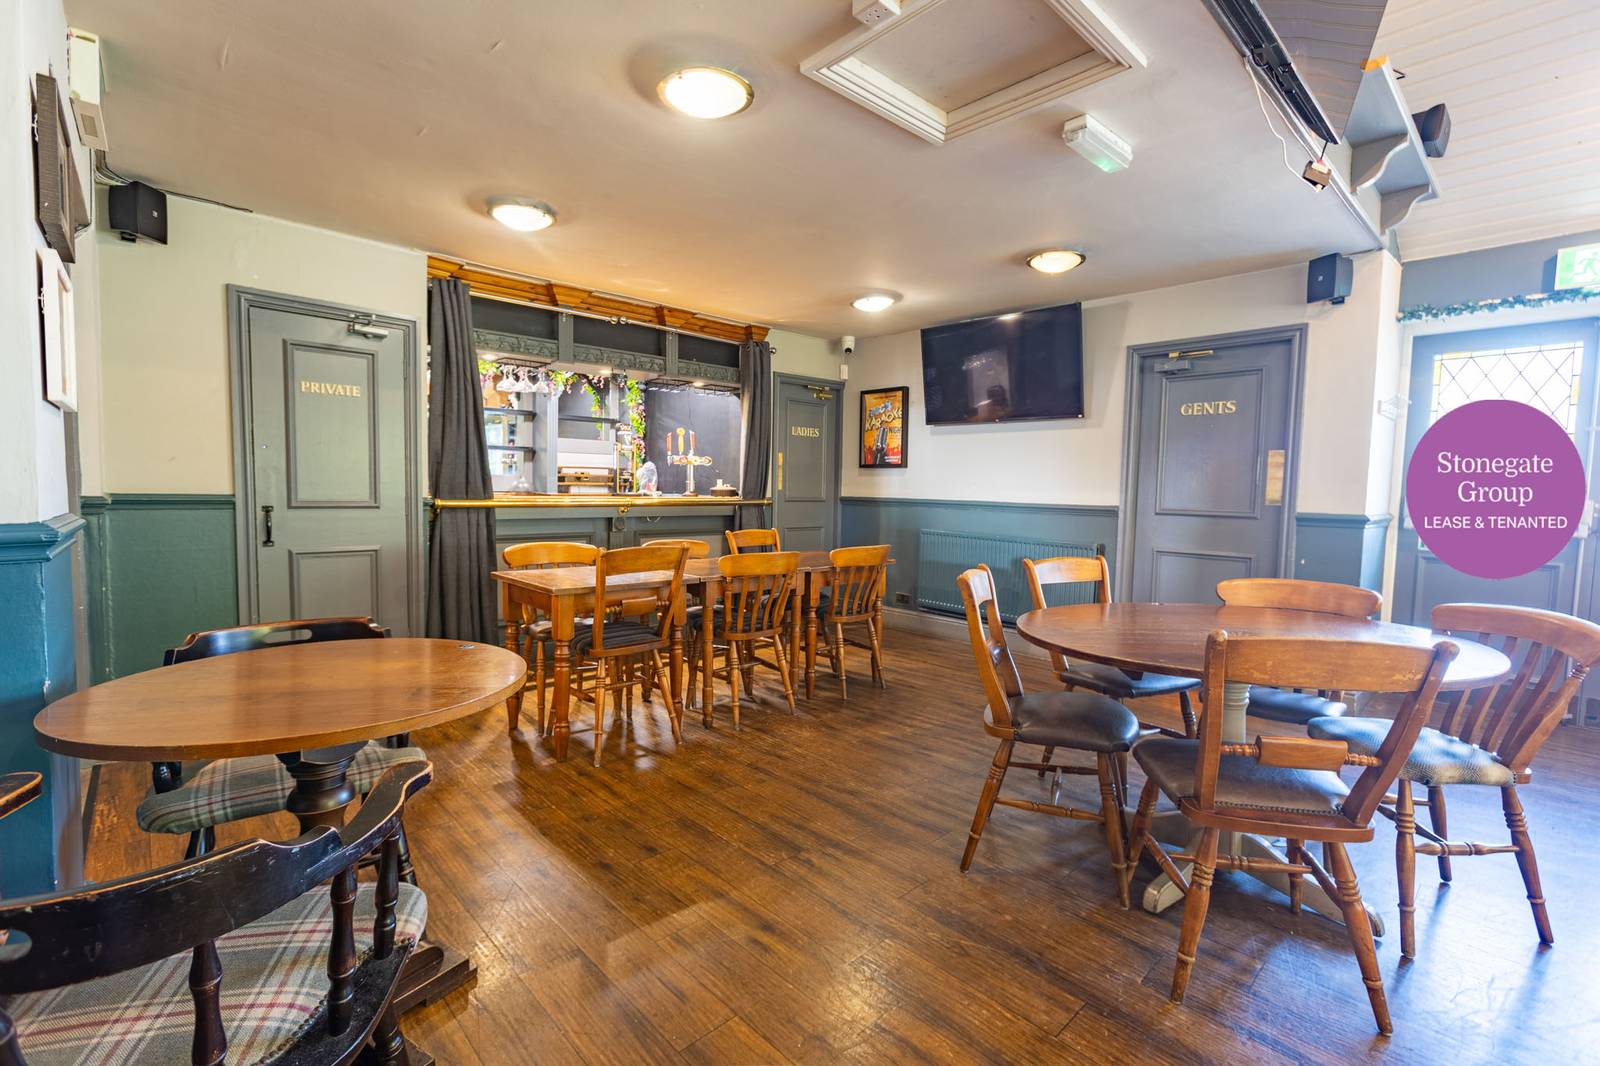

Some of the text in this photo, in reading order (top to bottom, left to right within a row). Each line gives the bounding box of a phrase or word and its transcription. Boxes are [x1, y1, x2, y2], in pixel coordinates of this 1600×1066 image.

[301, 381, 361, 397] PRIVATE
[1180, 400, 1237, 416] GENTS
[791, 425, 820, 438] LADIES
